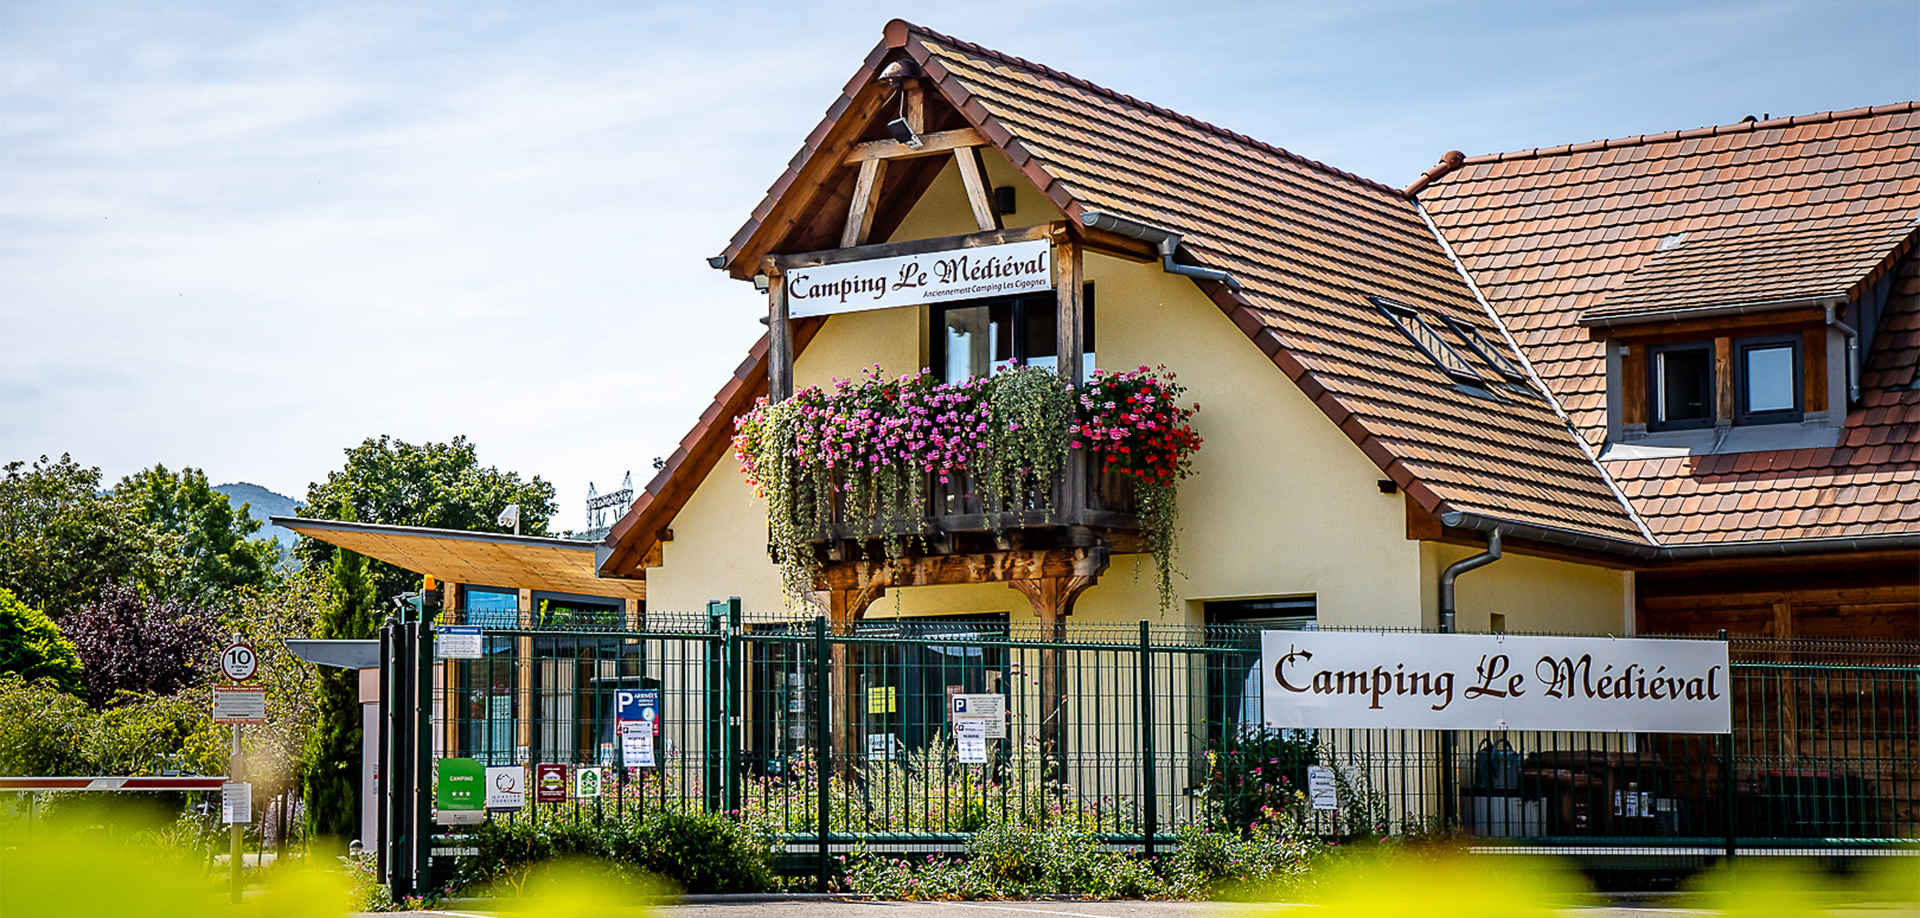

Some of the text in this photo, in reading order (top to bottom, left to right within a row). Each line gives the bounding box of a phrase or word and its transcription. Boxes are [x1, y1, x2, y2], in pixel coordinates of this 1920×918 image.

[789, 251, 1047, 303] Camping Le Médiéval
[922, 278, 1046, 298] Anciennement Camping Les Cigognes
[228, 650, 252, 665] 10
[1275, 644, 1721, 712] Camping Le Médiéval
[618, 692, 634, 713] P
[956, 700, 964, 711] P
